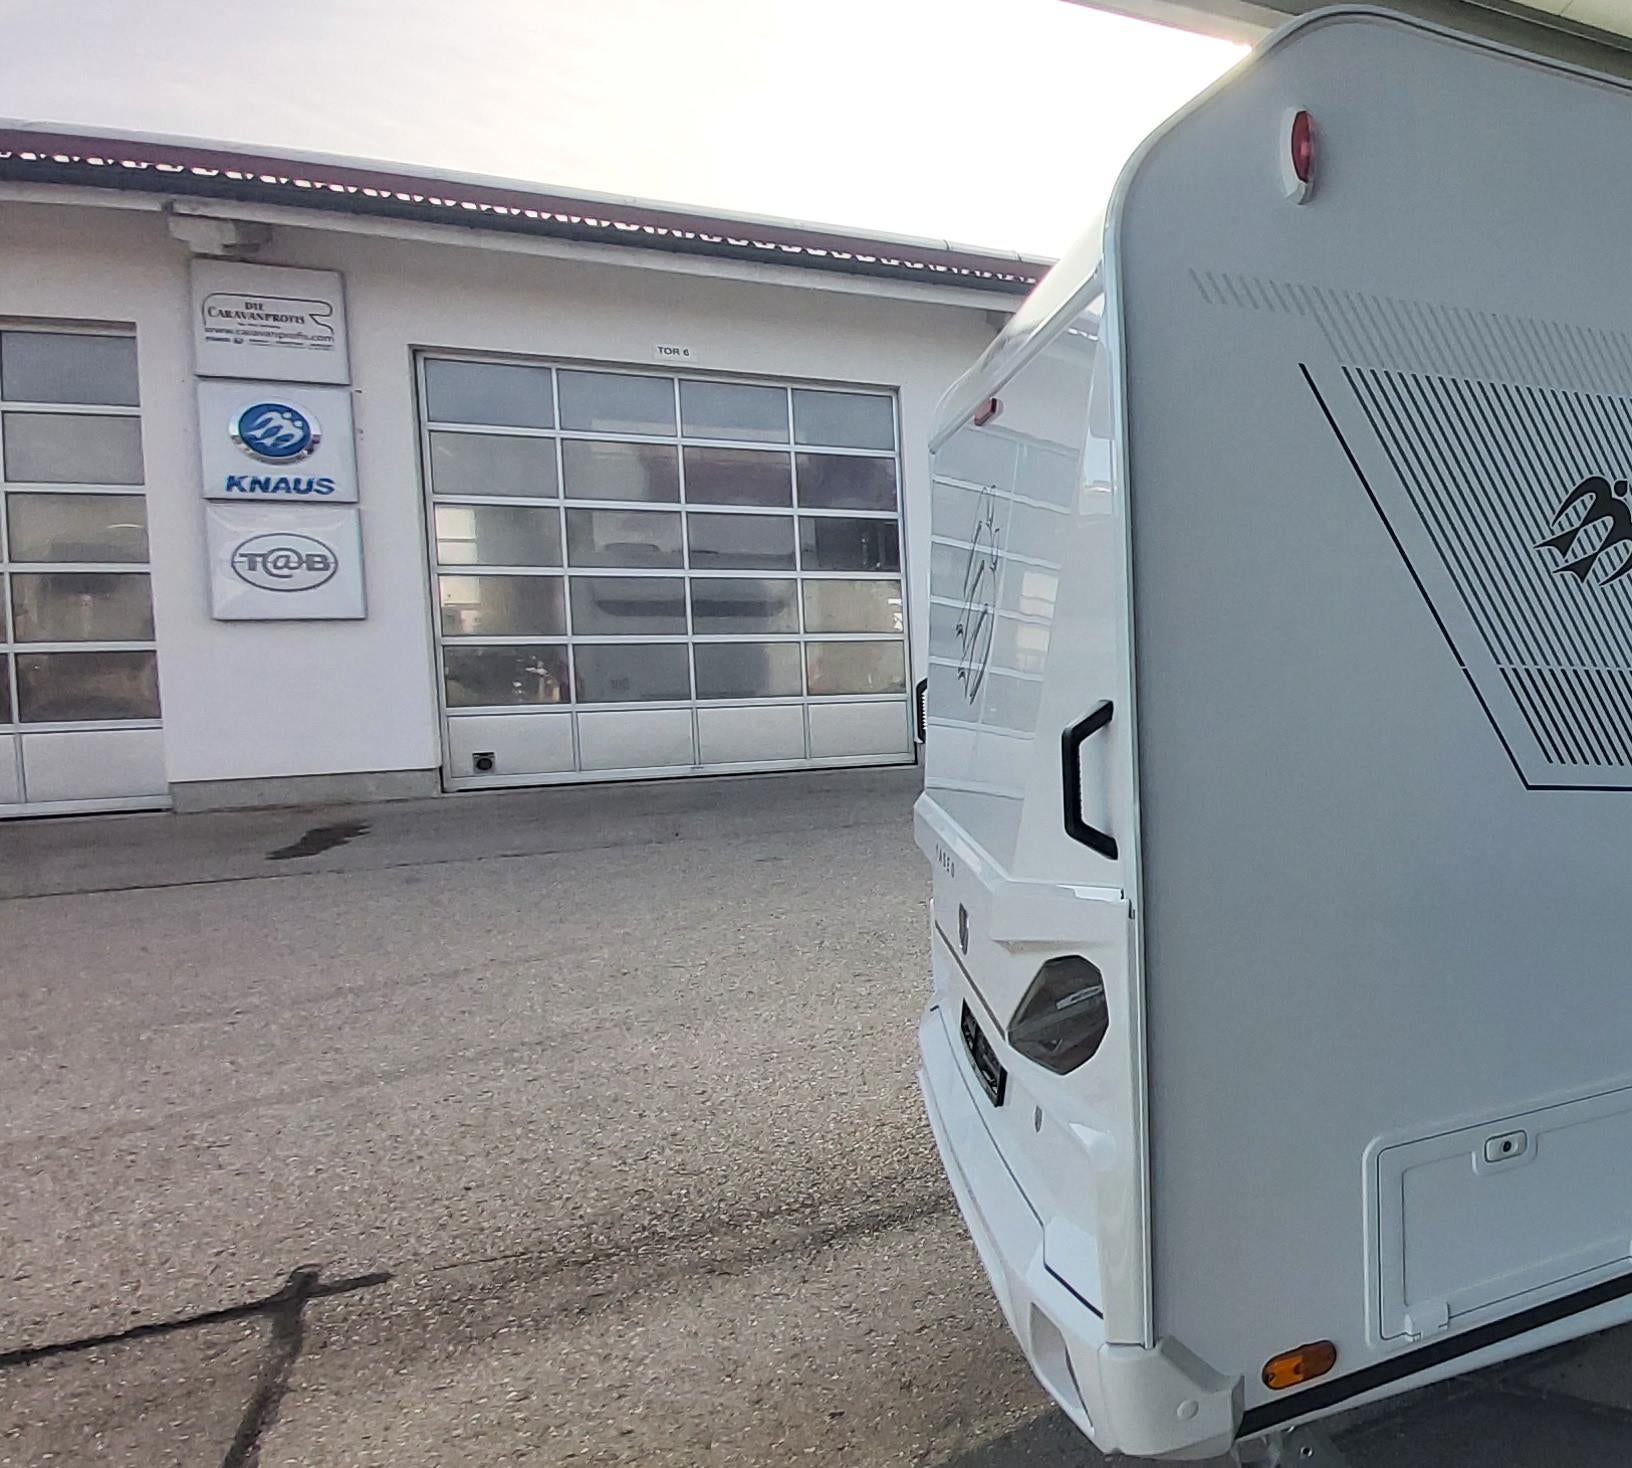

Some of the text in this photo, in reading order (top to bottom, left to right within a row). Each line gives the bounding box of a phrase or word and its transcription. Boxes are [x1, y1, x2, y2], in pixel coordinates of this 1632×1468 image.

[656, 345, 690, 357] TOR 6
[225, 474, 337, 495] KNAUS
[238, 547, 331, 579] T@B
